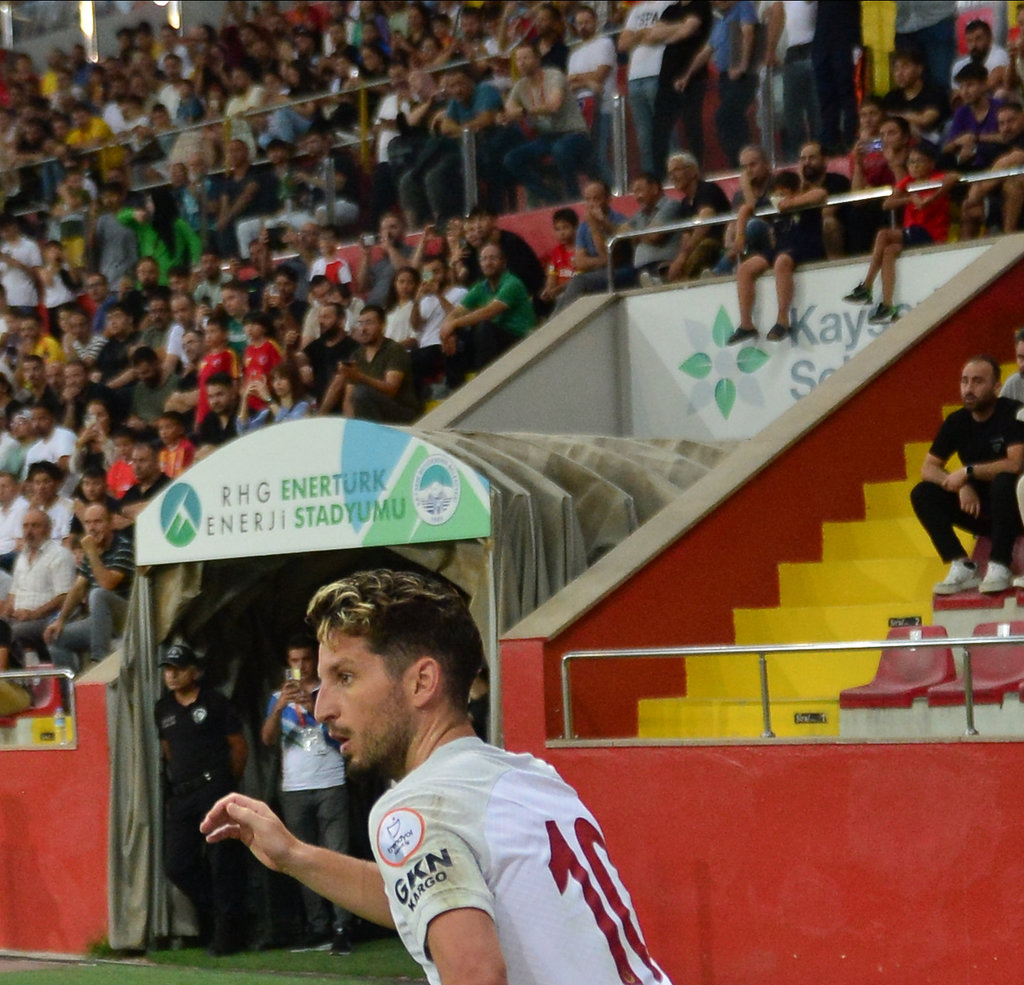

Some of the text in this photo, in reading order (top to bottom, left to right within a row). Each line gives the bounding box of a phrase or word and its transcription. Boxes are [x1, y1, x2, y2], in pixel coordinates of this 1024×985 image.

[222, 481, 271, 507] RHG
[294, 497, 407, 529] STADYUMU
[394, 848, 453, 906] GKN
[407, 871, 447, 912] KARGO
